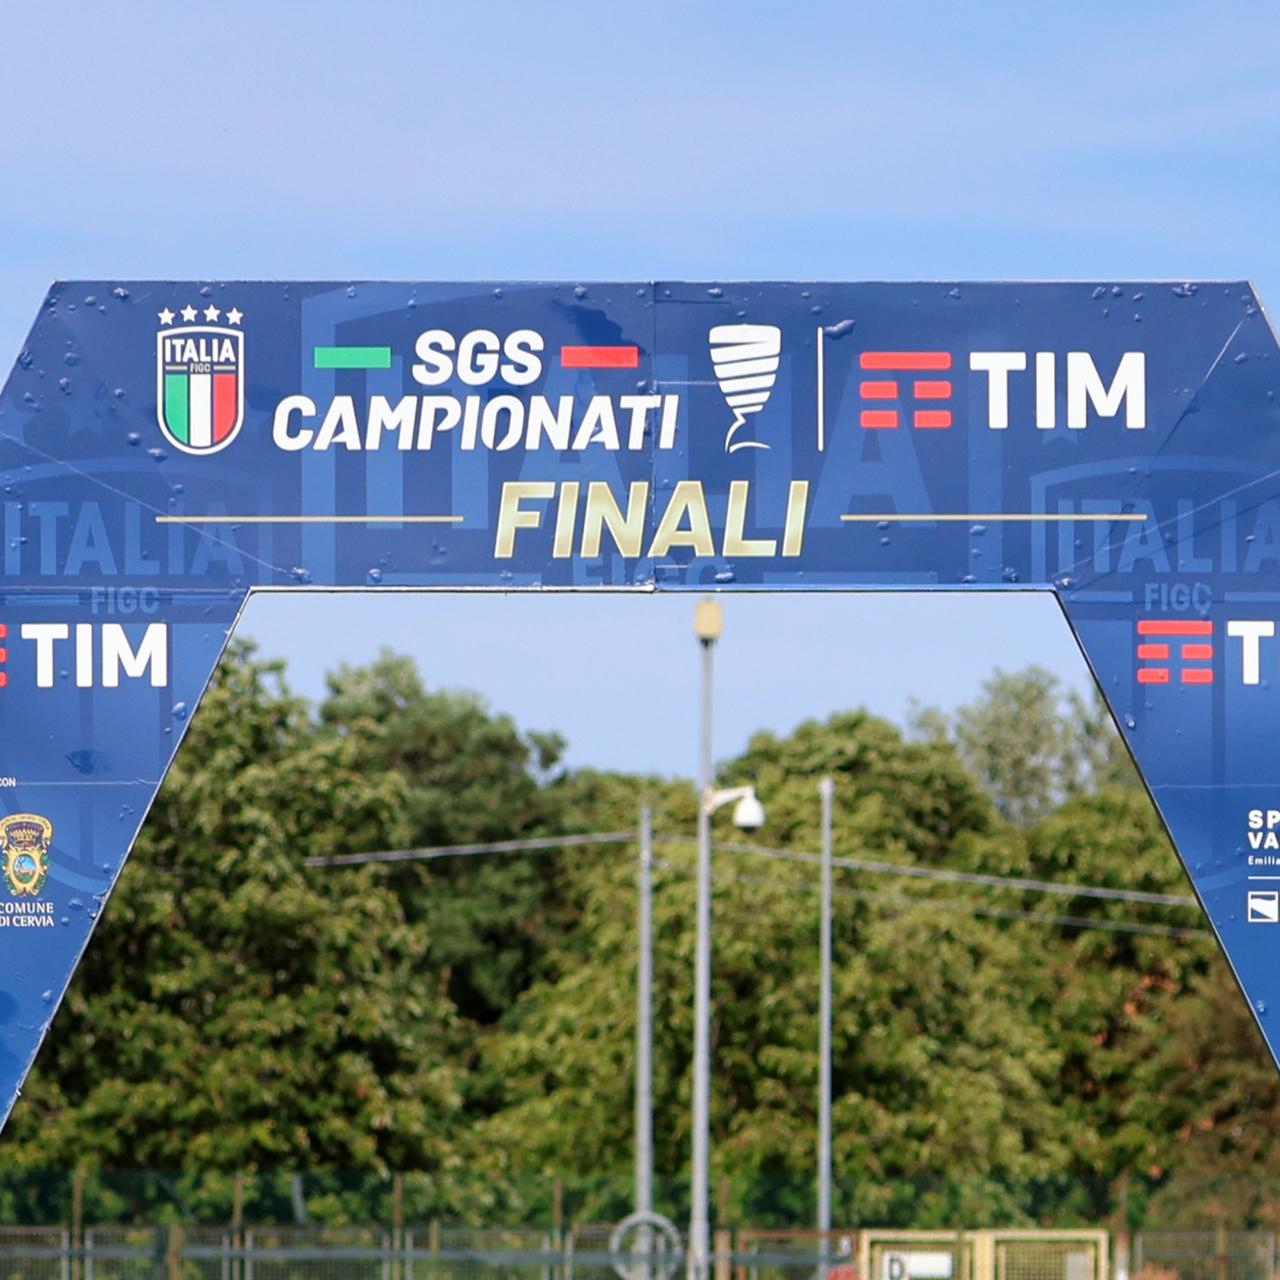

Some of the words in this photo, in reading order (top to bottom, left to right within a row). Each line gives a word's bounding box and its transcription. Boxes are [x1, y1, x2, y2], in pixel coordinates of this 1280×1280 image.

[164, 338, 236, 363] ITALIA
[189, 363, 211, 373] FIGC
[412, 330, 544, 386] SGS
[969, 351, 1146, 430] TIM
[272, 394, 679, 452] CAMPIONATI
[4, 501, 245, 576] ITALIA
[494, 480, 809, 558] FINALI
[90, 586, 160, 615] FIGC
[1144, 582, 1212, 612] FIGC
[20, 622, 168, 688] TIM
[12, 916, 54, 927] CERVIA
[889, 1258, 904, 1280] D
